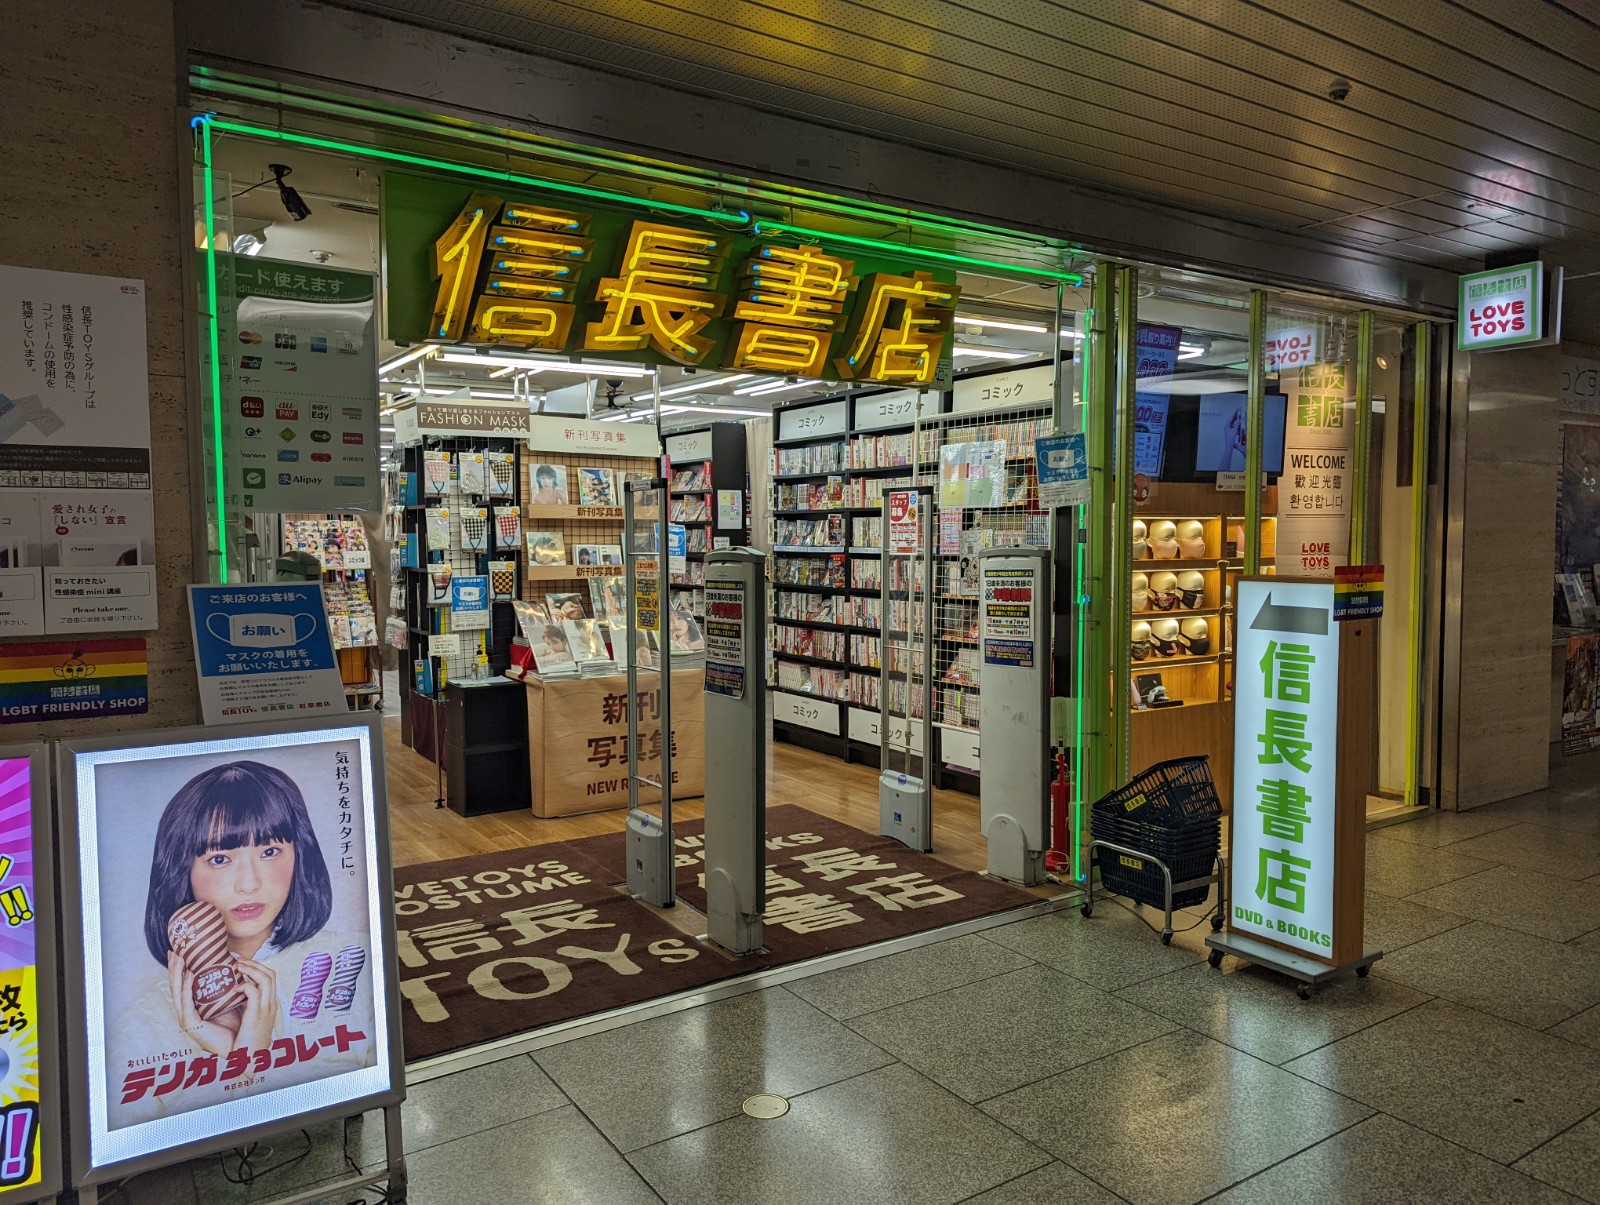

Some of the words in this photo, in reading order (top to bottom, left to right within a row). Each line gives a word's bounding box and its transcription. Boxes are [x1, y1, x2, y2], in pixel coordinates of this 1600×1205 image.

[430, 192, 962, 384] 信長書店
[1469, 300, 1526, 322] LOVE
[1469, 317, 1526, 338] TOYS
[22, 300, 36, 372] 推奨しています。
[42, 302, 56, 388] コンドームの使用を
[62, 304, 76, 393] 性感染症予防の為に、
[81, 305, 96, 409] 信長TOYSグループは
[982, 382, 1024, 400] コミック
[312, 411, 329, 420] Edy
[879, 400, 912, 416] コミック
[420, 412, 483, 426] FASHION
[489, 416, 526, 428] MASK
[798, 414, 825, 428] コミック
[564, 428, 626, 444] 新刊写真集
[678, 440, 698, 451] コミック
[1291, 455, 1346, 470] WELCOME
[293, 475, 322, 484] Alipay
[1294, 474, 1342, 490] 歡迎光臨
[52, 504, 116, 514] 愛され女子の
[1290, 494, 1344, 510] 환영합니다
[577, 507, 623, 518] 新刊写真集
[1301, 542, 1330, 554] LOVE
[576, 566, 622, 577] 新刊写真集
[1302, 557, 1330, 570] TOYS
[210, 592, 308, 604] ご来店のお客様へ
[1334, 608, 1346, 616] LGBT
[1348, 607, 1370, 615] FRIENDLY
[60, 616, 144, 624] ご自由にお持ち帰り下さい。
[242, 625, 286, 636] お願い
[226, 649, 308, 661] マスクの着用を
[218, 658, 318, 673] お願いいたします。
[2, 704, 39, 716] LGBT
[42, 700, 106, 714] FRIENDLY
[110, 698, 146, 708] SHOP
[602, 689, 662, 724] 新刊
[792, 704, 819, 720] コミック
[588, 730, 678, 768] 写真集
[587, 780, 618, 796] NEW
[621, 771, 679, 791] RLEAE
[1254, 640, 1316, 914] 信長書店
[335, 751, 356, 876] 気持ちをカタチに。
[394, 860, 569, 899] VETOYS
[395, 871, 591, 916] OSTUME
[762, 872, 966, 934] 書店
[396, 899, 616, 968] 信長
[1234, 906, 1263, 926] DVD
[1266, 919, 1274, 928] &
[1277, 922, 1332, 948] BOOKS
[400, 932, 700, 1023] TOYS
[120, 1053, 219, 1104] テンガ
[220, 1024, 367, 1082] チョコレート
[127, 1048, 192, 1068] おいしいたのしい
[224, 1076, 266, 1092] 株式会社テンガ
